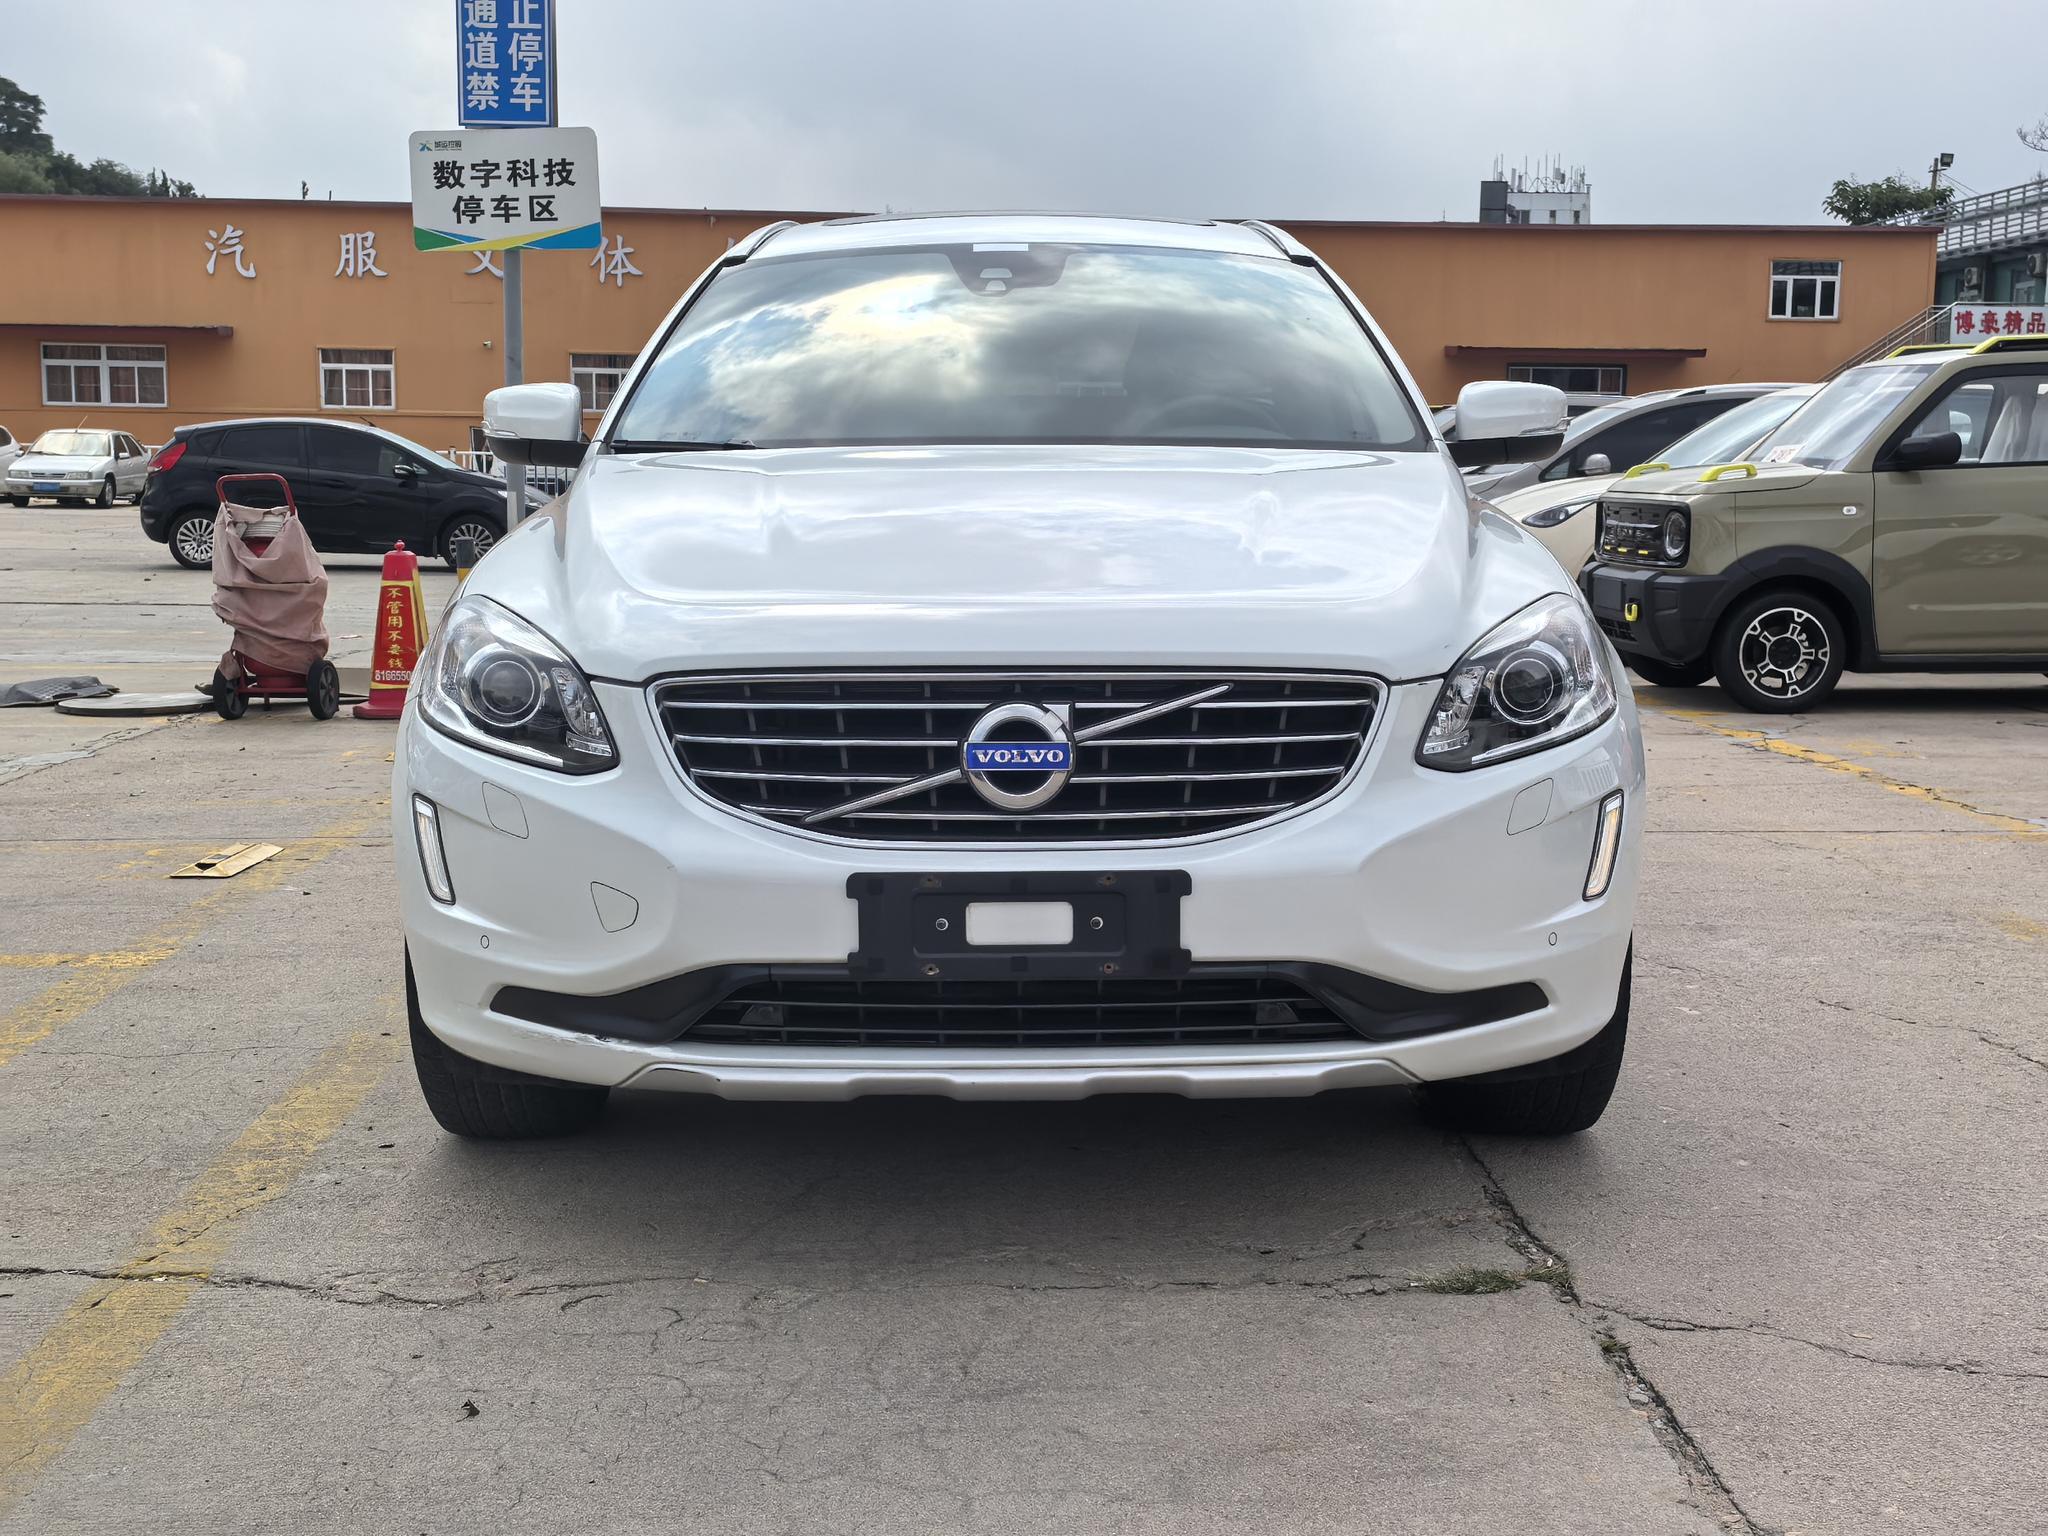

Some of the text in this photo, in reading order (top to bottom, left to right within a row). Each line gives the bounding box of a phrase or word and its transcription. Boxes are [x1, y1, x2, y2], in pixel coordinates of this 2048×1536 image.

[464, 0, 500, 111] 通道禁
[507, 0, 543, 112] 止停车
[433, 158, 576, 189] 数字科技
[452, 195, 558, 224] 停车区
[1954, 309, 2046, 335] 博豪精品
[972, 749, 1064, 763] VOLVO
